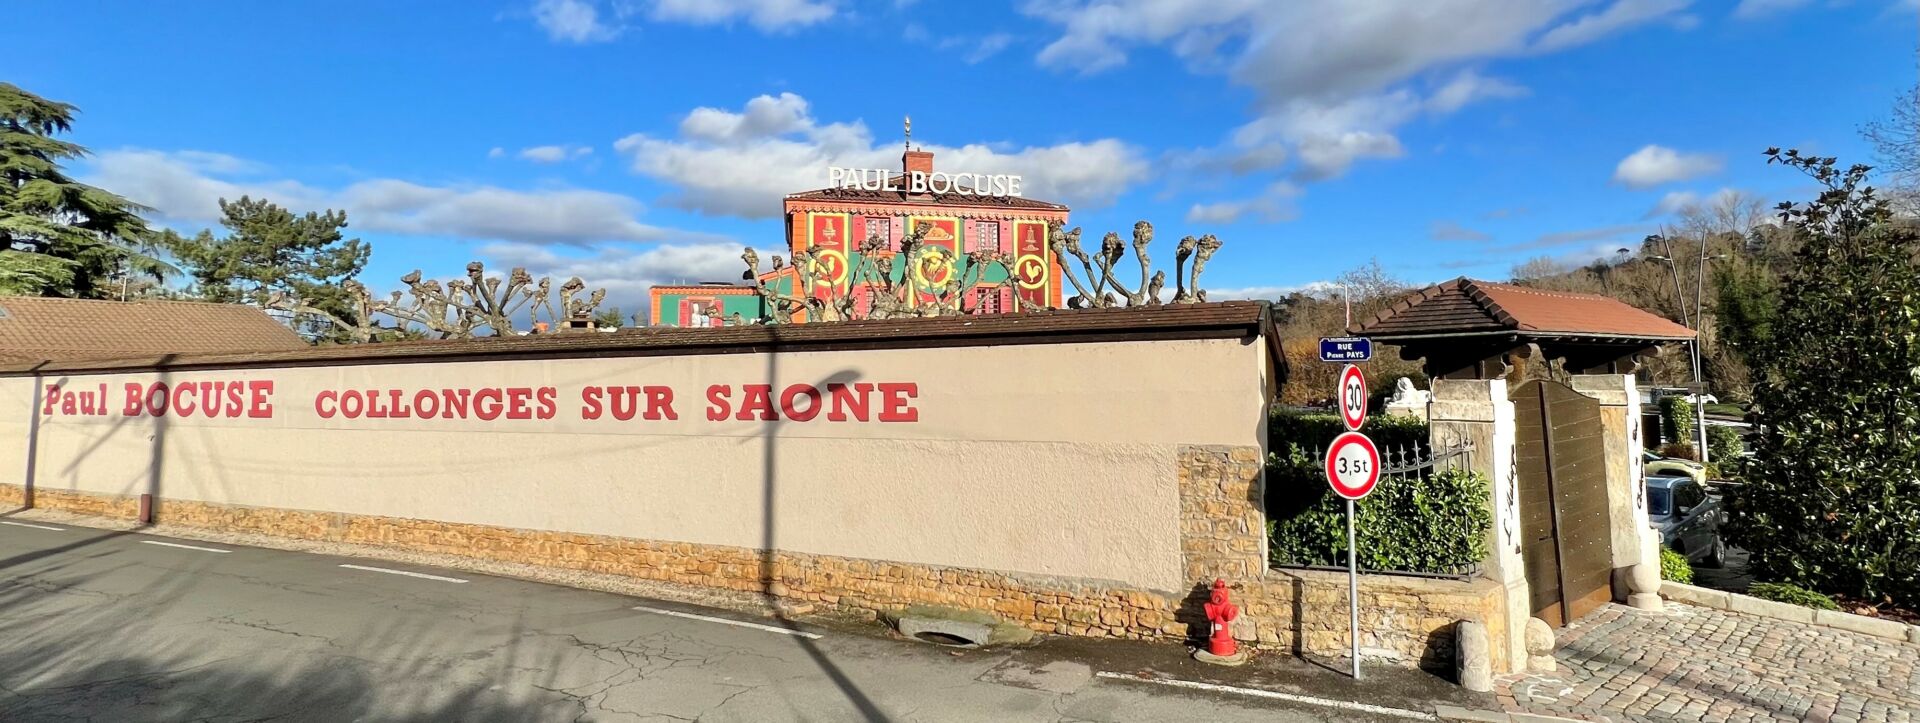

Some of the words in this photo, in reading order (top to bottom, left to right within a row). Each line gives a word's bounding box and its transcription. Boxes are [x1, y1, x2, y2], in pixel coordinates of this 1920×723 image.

[828, 166, 898, 192] PAUL
[910, 170, 1022, 197] BOCUSE
[43, 383, 107, 416] Paul
[123, 380, 274, 418] BOCUSE
[315, 386, 557, 421] COLLONGES
[581, 385, 679, 421] SUR
[706, 382, 919, 422] SAONE
[1347, 383, 1362, 411] 30
